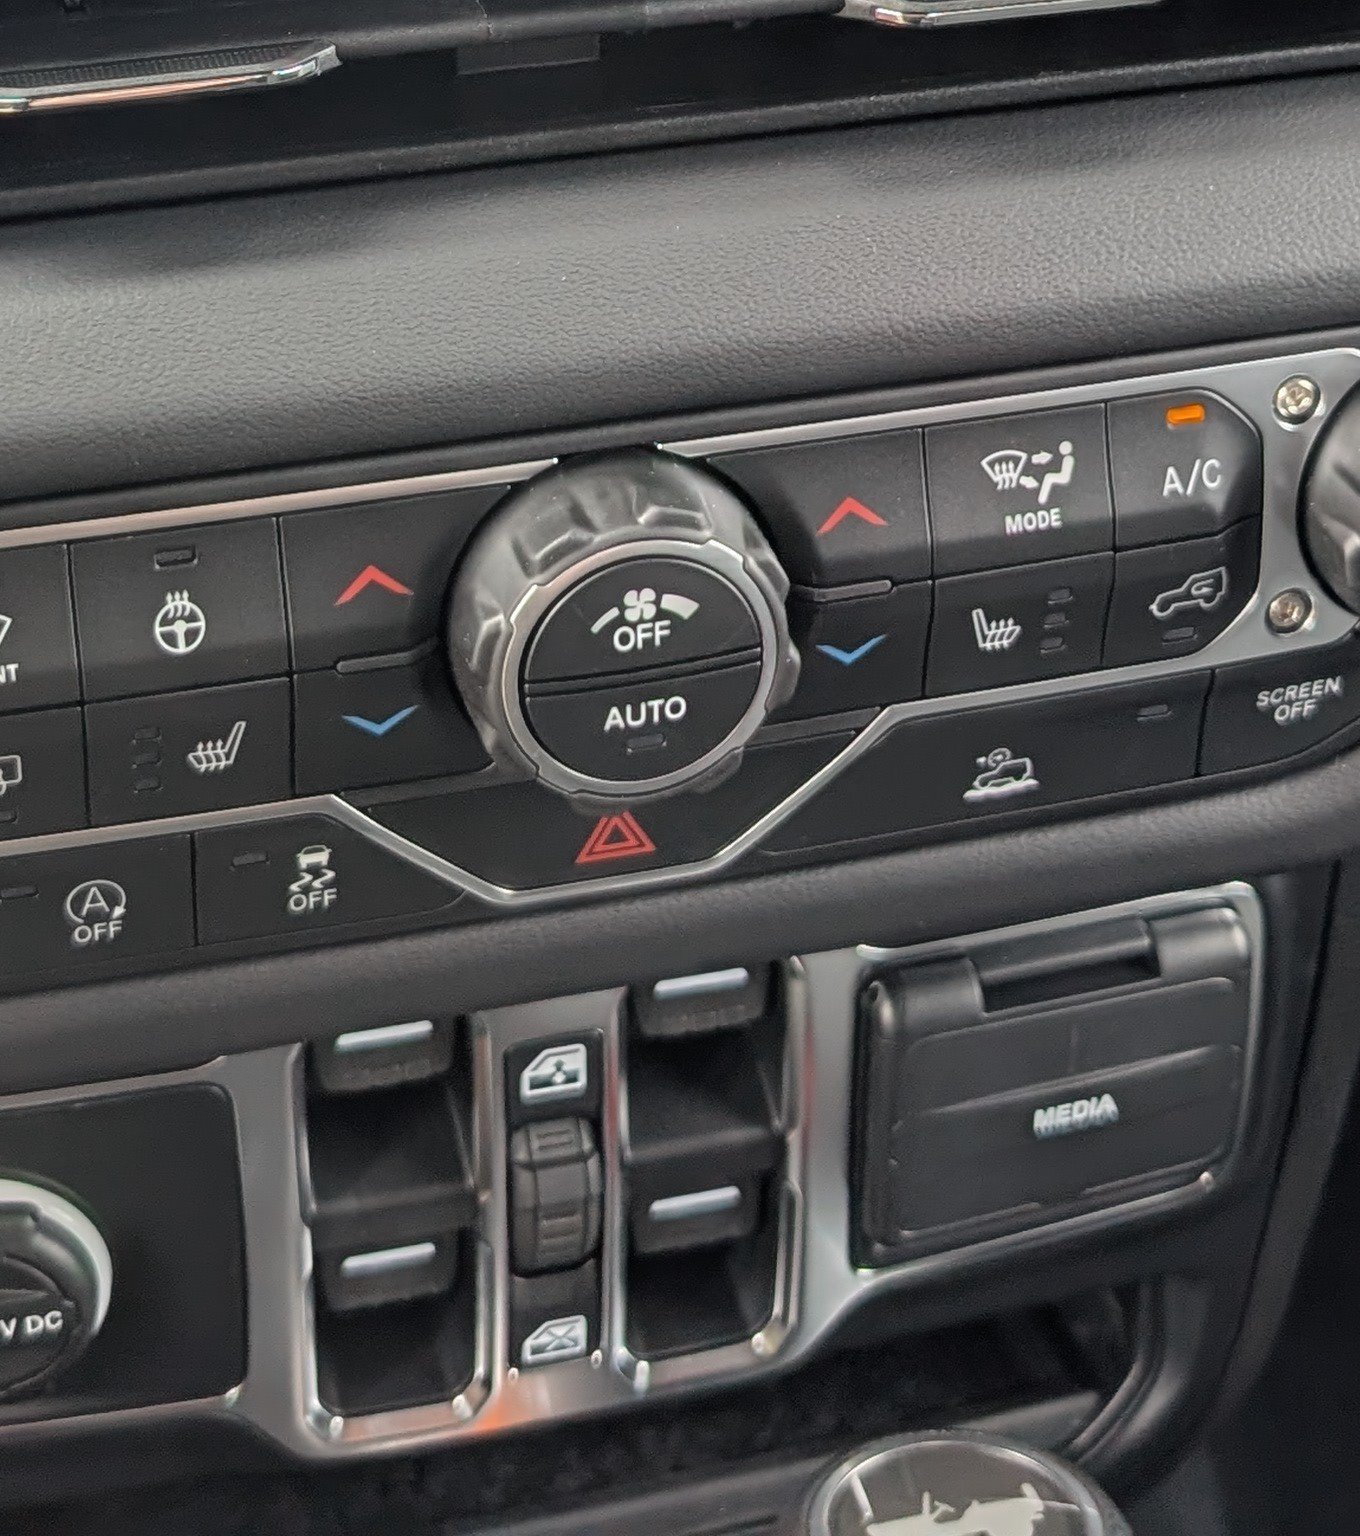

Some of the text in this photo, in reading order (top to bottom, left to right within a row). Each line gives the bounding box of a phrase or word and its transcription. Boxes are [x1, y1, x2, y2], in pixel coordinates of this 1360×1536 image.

[1162, 458, 1222, 500] A/C
[1005, 508, 1062, 534] MODE
[613, 620, 672, 652] OFF
[1257, 676, 1342, 708] SCREEN
[603, 697, 688, 732] AUTO
[1274, 697, 1318, 724] OFF
[287, 887, 337, 913] OFF
[73, 920, 123, 943] OFF
[1033, 1094, 1118, 1137] MEDIA
[24, 1310, 63, 1335] DC
